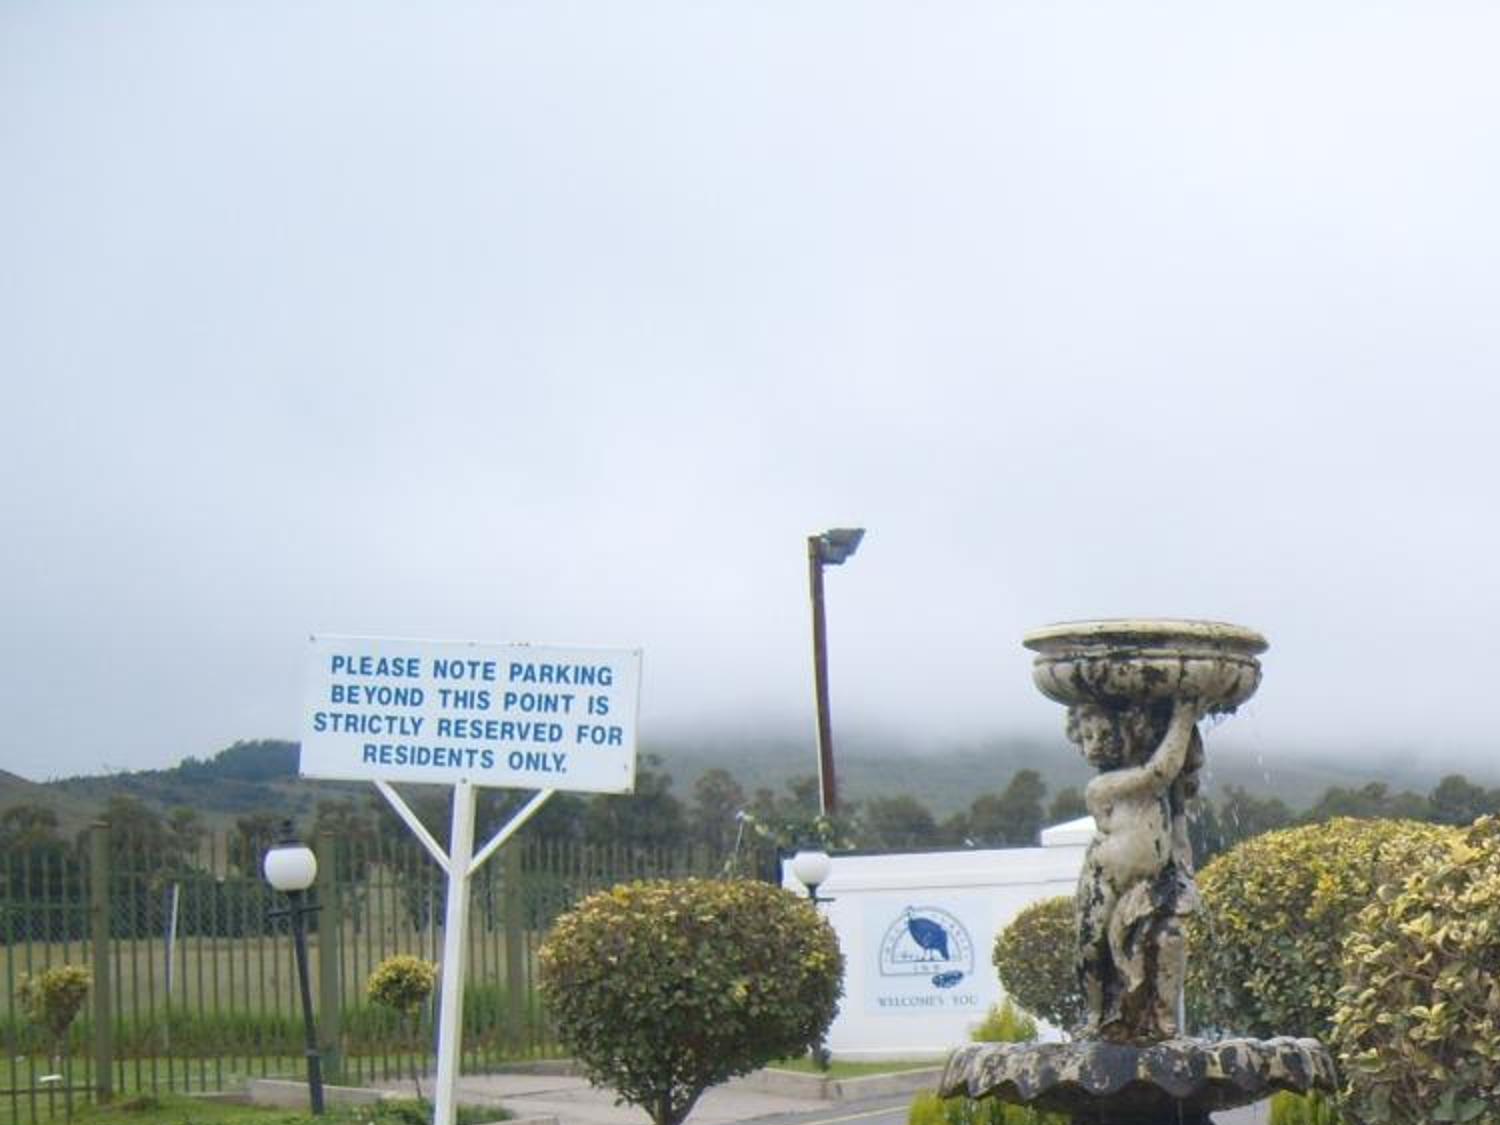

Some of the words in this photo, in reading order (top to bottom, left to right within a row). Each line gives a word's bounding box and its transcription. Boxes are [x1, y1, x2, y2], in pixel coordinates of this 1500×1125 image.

[331, 654, 421, 679] PLEASE
[432, 659, 497, 682] NOTE
[509, 662, 614, 687] PARKING
[330, 684, 425, 708] BEYOND
[438, 689, 492, 711] THIS
[502, 691, 576, 714] POINT
[587, 695, 610, 716] IS
[313, 712, 425, 737] STRICTLY
[436, 719, 564, 743] RESERVED
[576, 725, 624, 746] FOR
[362, 744, 495, 769] RESIDENTS
[507, 751, 567, 774] ONLY.
[952, 994, 977, 1006] YOU
